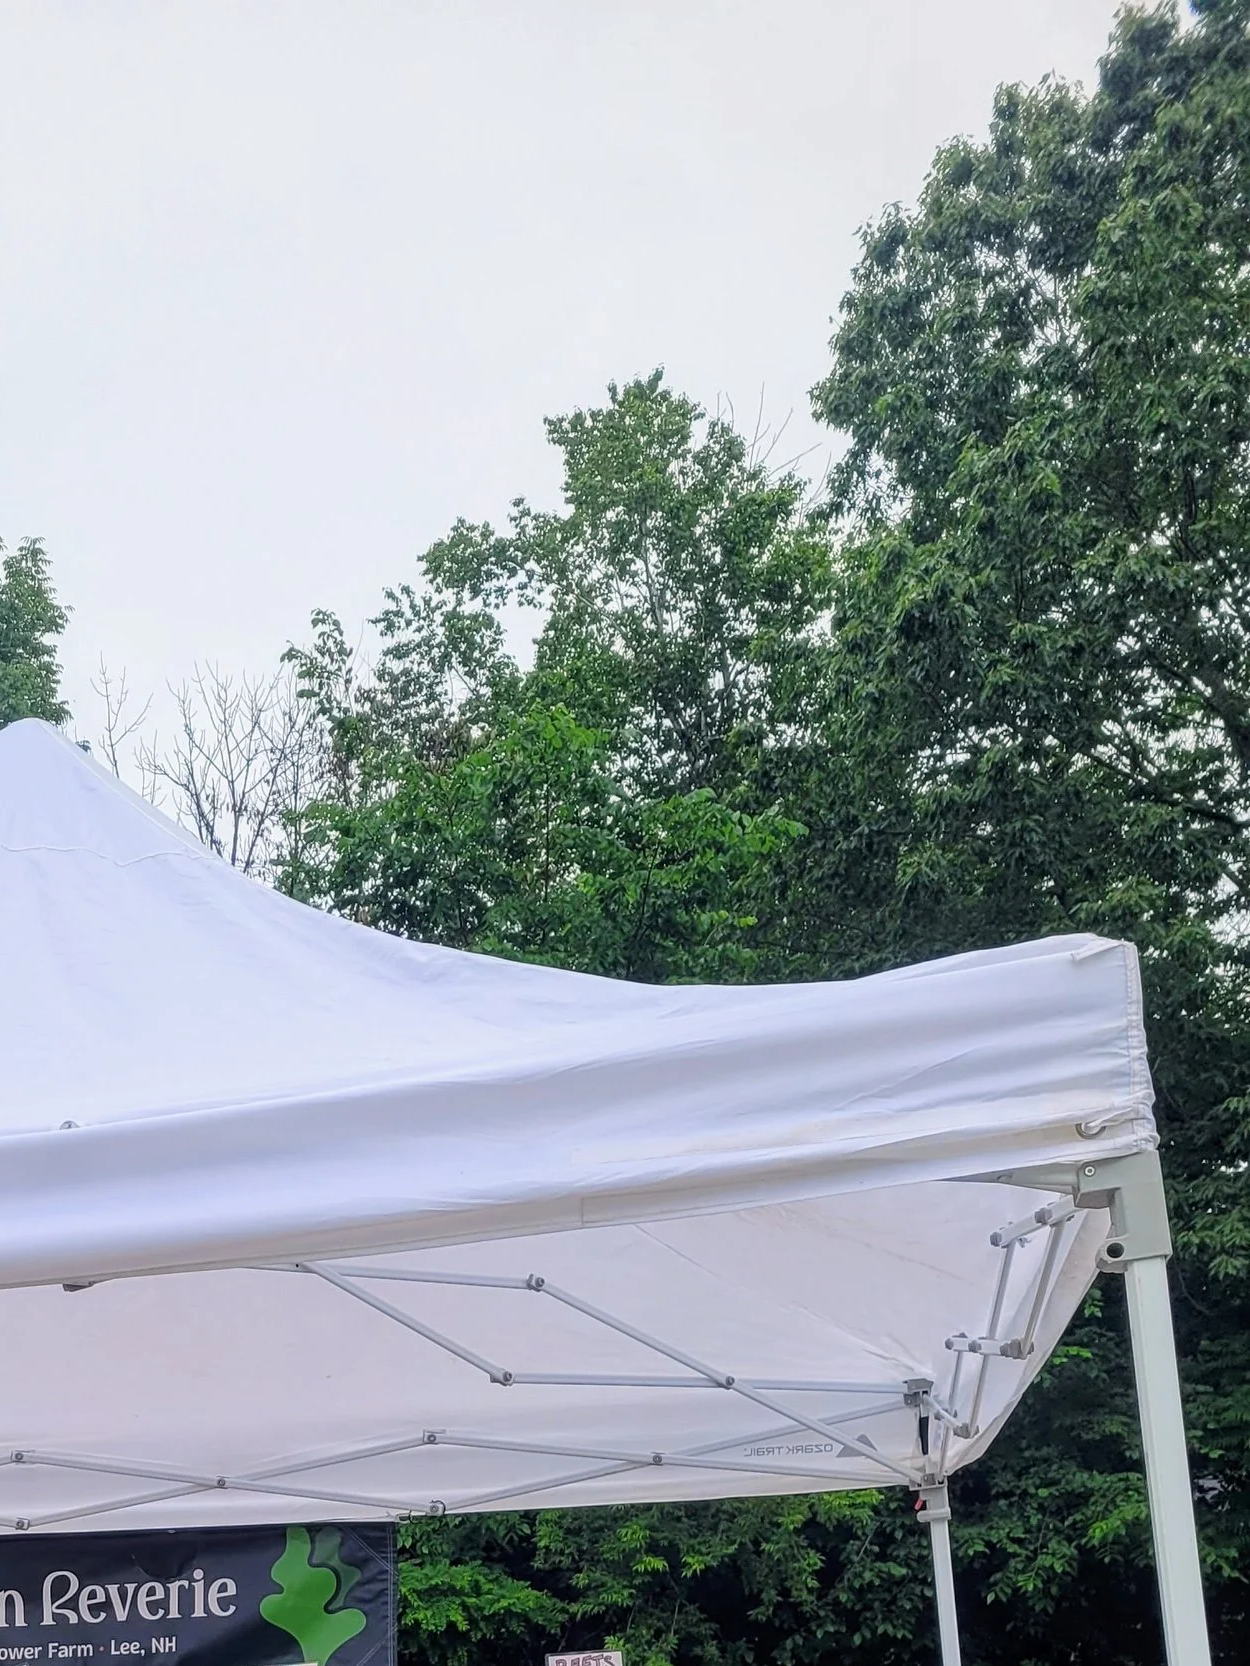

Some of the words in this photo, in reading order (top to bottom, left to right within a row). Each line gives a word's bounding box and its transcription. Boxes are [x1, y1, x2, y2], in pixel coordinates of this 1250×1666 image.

[39, 1568, 238, 1626] Reverie
[47, 1642, 94, 1659] Farm
[110, 1639, 146, 1656] Lee,
[150, 1636, 177, 1654] NH
